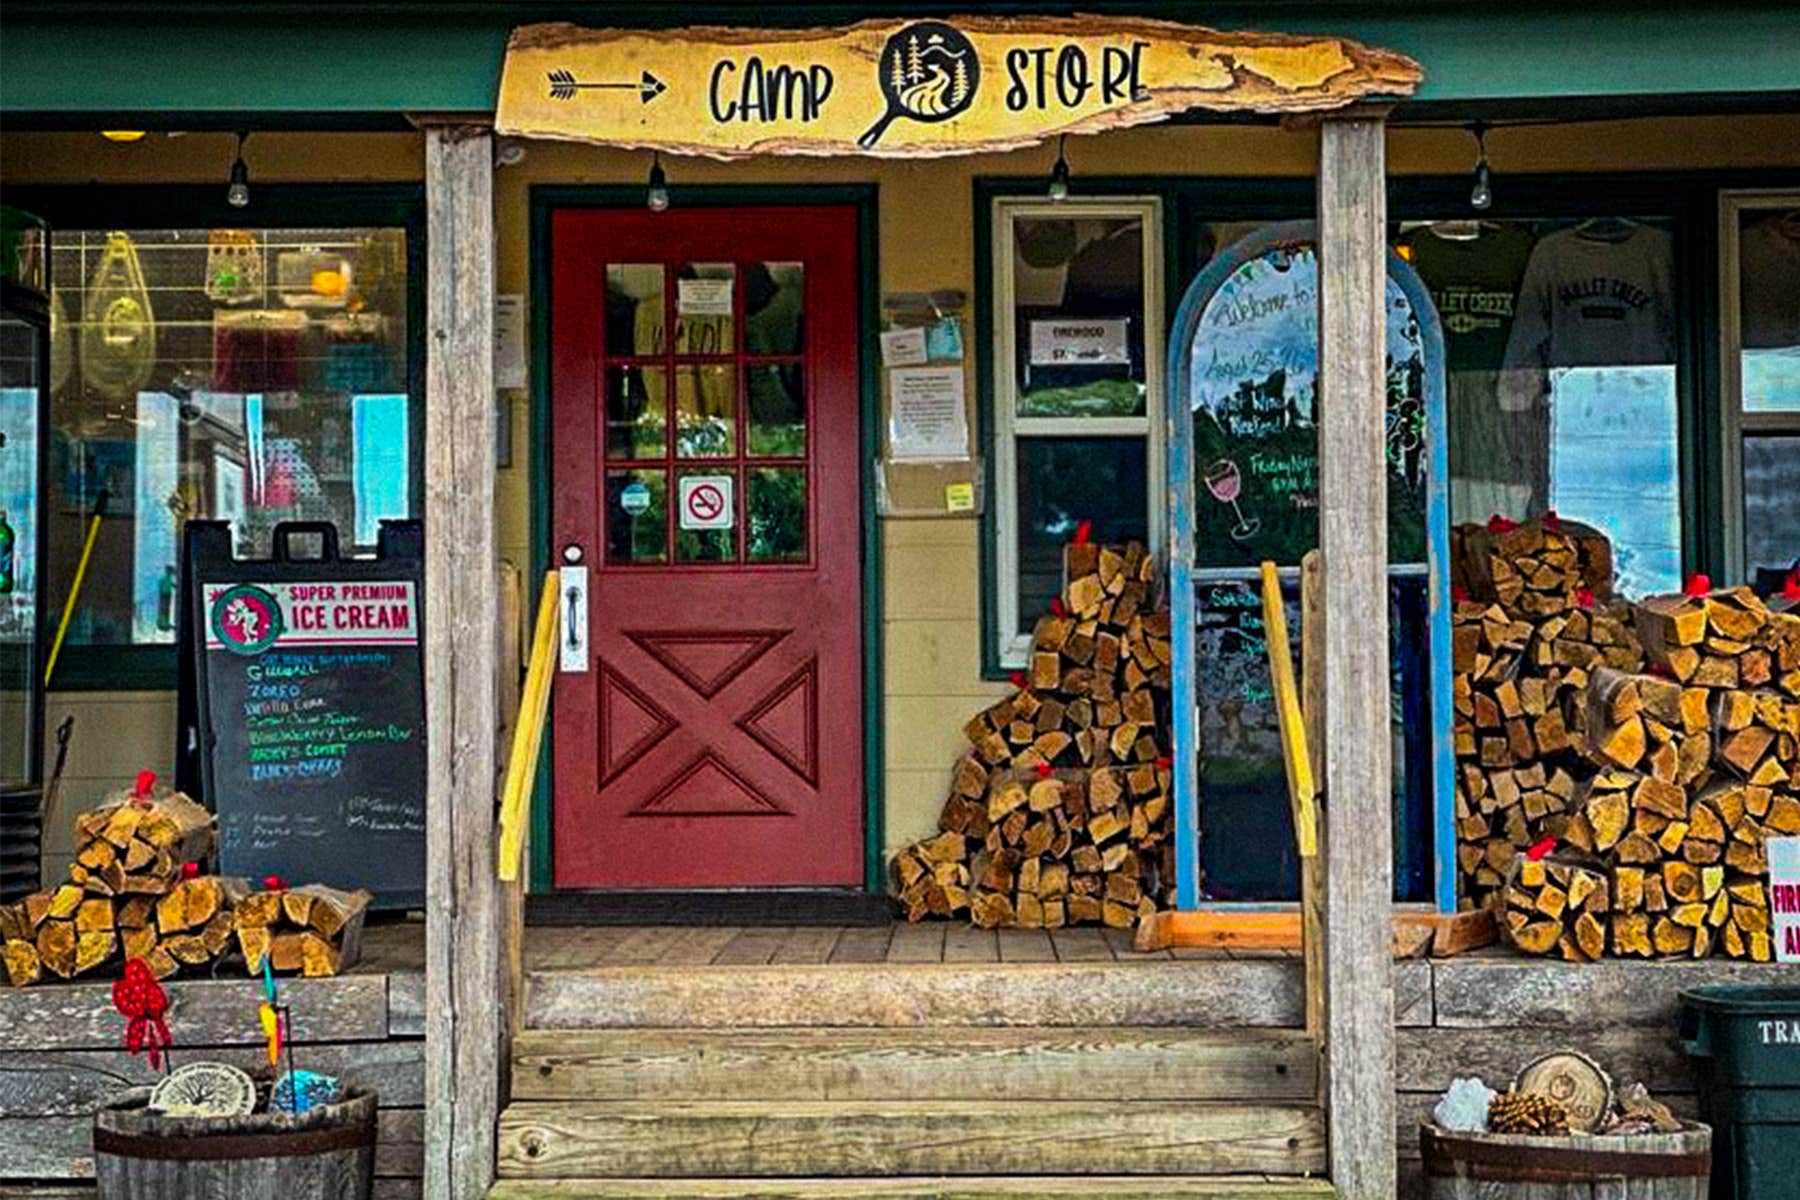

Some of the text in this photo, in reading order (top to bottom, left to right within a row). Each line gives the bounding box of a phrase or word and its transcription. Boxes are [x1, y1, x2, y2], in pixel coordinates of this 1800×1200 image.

[709, 42, 1151, 122] CAMP STORE
[289, 585, 407, 600] SUPER PREMIUM
[292, 604, 409, 630] ICE CREAM
[1773, 884, 1800, 913] FIR
